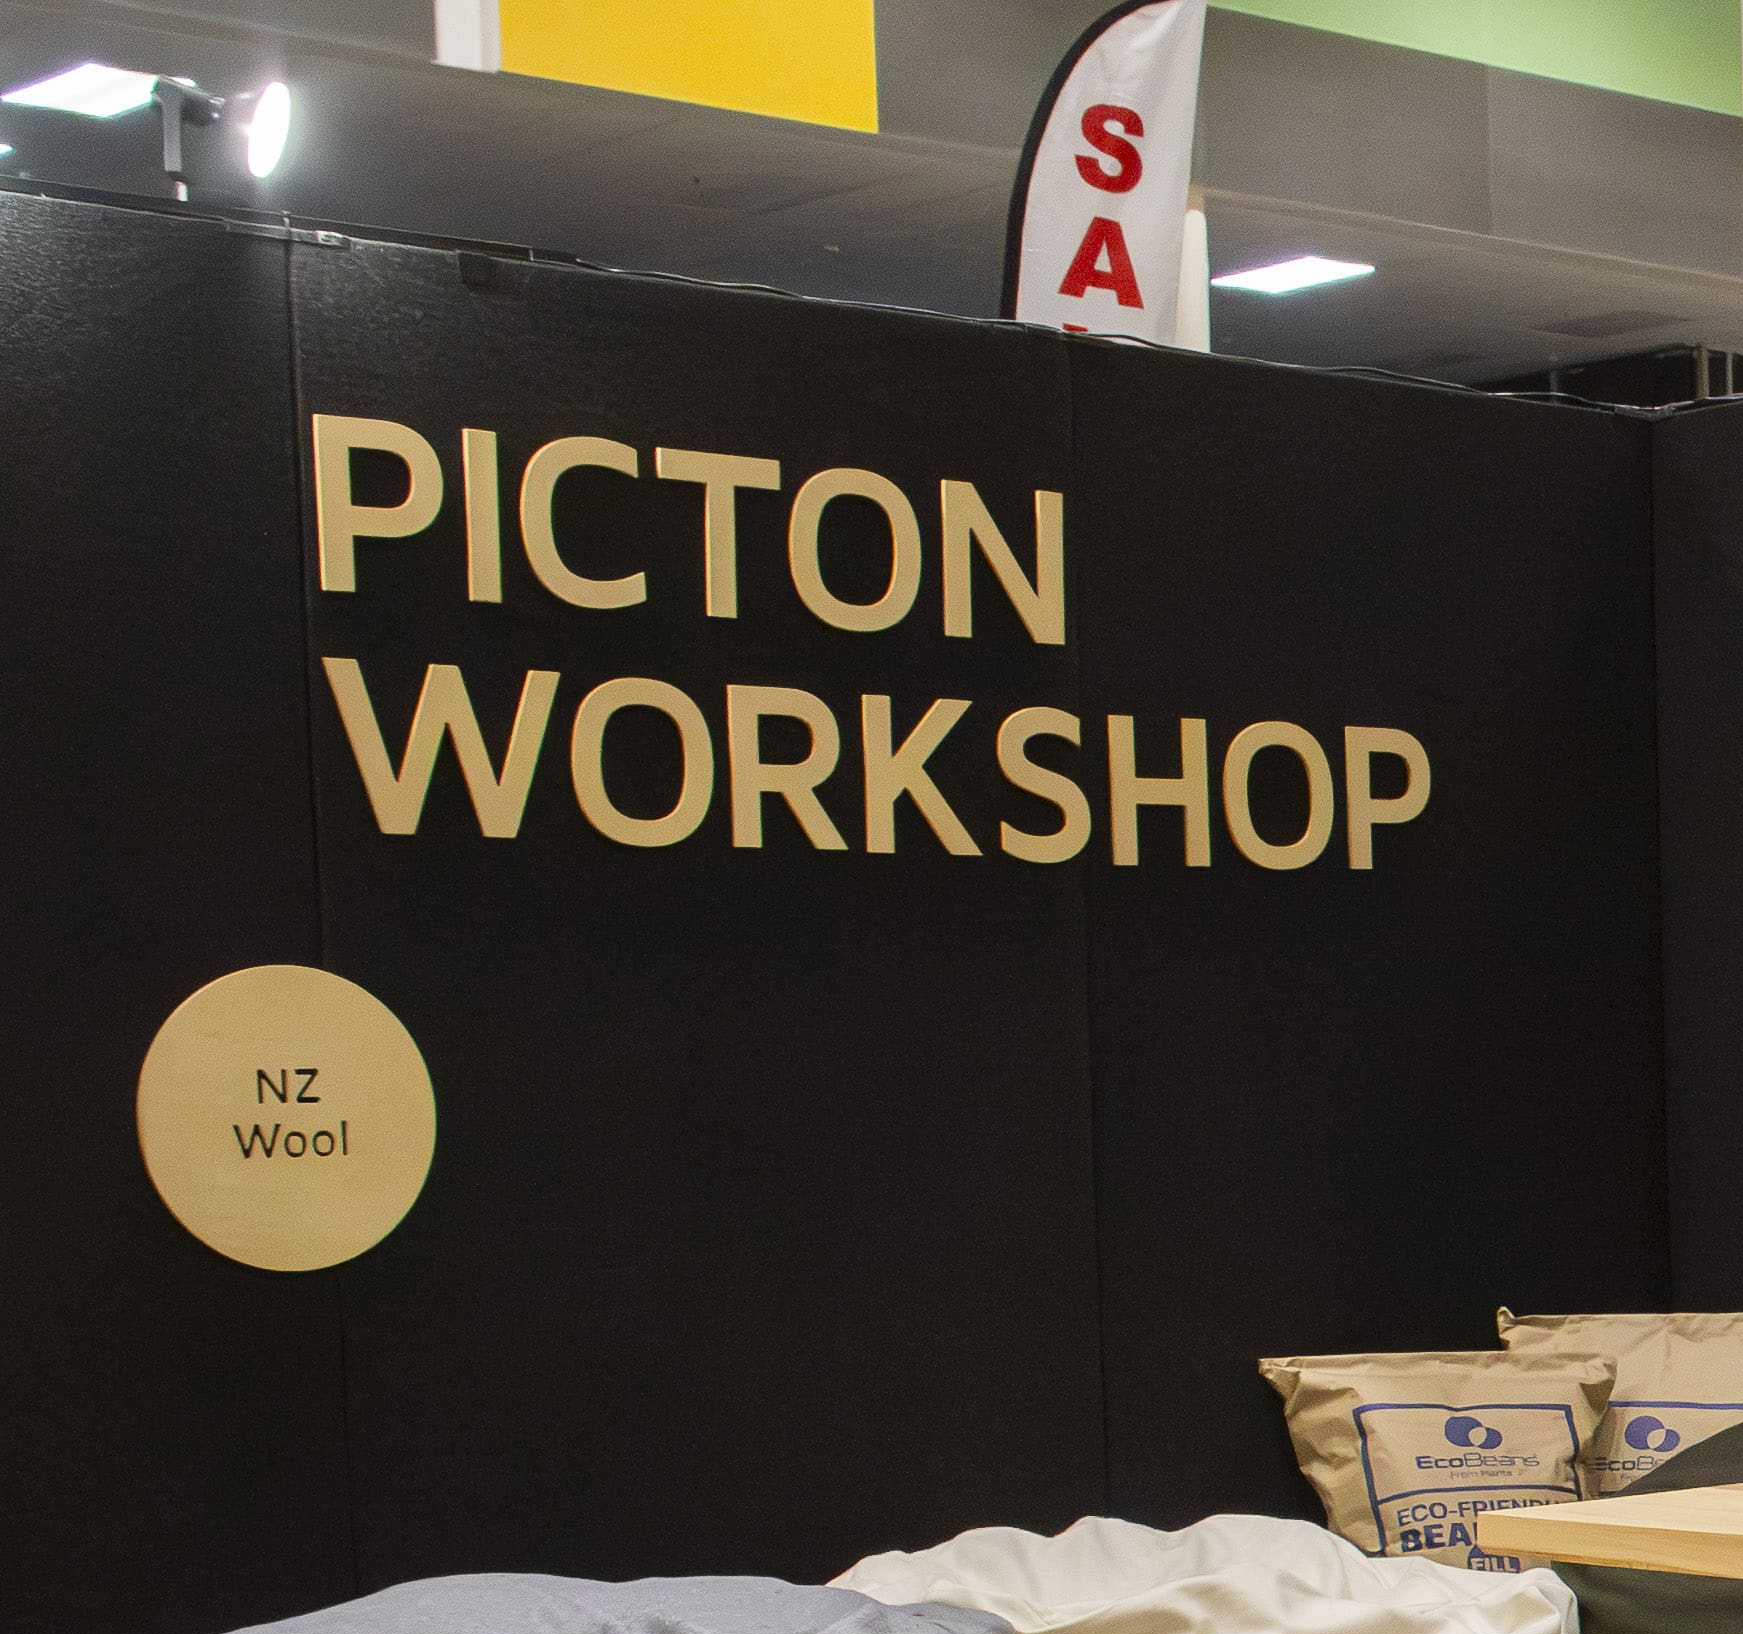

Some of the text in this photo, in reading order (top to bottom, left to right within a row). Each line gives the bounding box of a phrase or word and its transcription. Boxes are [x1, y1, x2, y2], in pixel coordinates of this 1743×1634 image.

[1057, 103, 1145, 333] SA
[312, 413, 1066, 646] PICTON
[321, 655, 1432, 870] WORKSHOP
[256, 1068, 321, 1104] NZ
[232, 1120, 349, 1160] Wool
[1414, 1452, 1540, 1470] EcoBeans
[1397, 1498, 1559, 1527] ECO-FRIE
[1400, 1522, 1477, 1553] BEA
[1470, 1557, 1518, 1571] FILL
